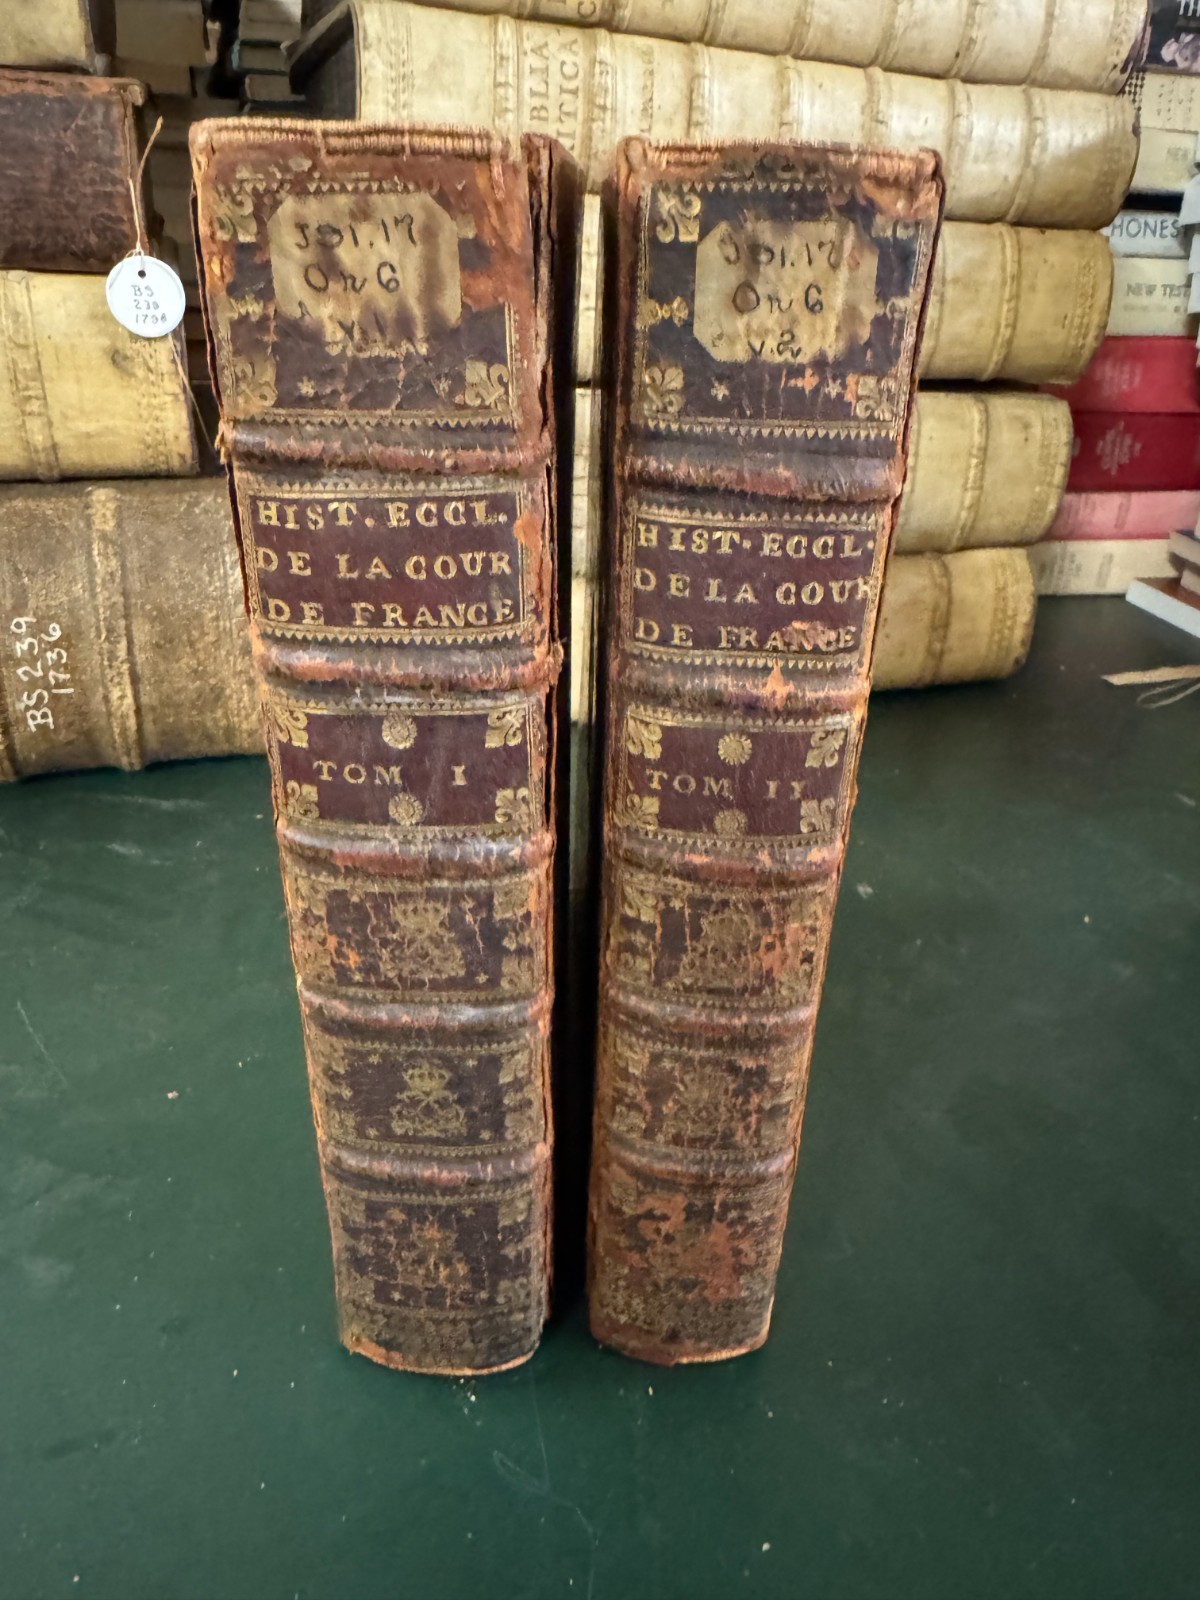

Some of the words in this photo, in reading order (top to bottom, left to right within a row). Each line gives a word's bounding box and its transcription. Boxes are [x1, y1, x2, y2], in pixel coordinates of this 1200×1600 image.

[257, 547, 312, 577] DE
[335, 553, 393, 580] LA
[405, 551, 513, 580] COUR
[633, 567, 691, 599] DE
[704, 578, 759, 604] LA
[267, 598, 325, 625] DE
[351, 598, 515, 628] FRANCE
[10, 616, 44, 682] 239
[634, 617, 694, 648] DE
[40, 622, 75, 695] 1736
[22, 688, 55, 733] BS
[313, 759, 403, 785] TOM
[646, 768, 734, 801] TOM
